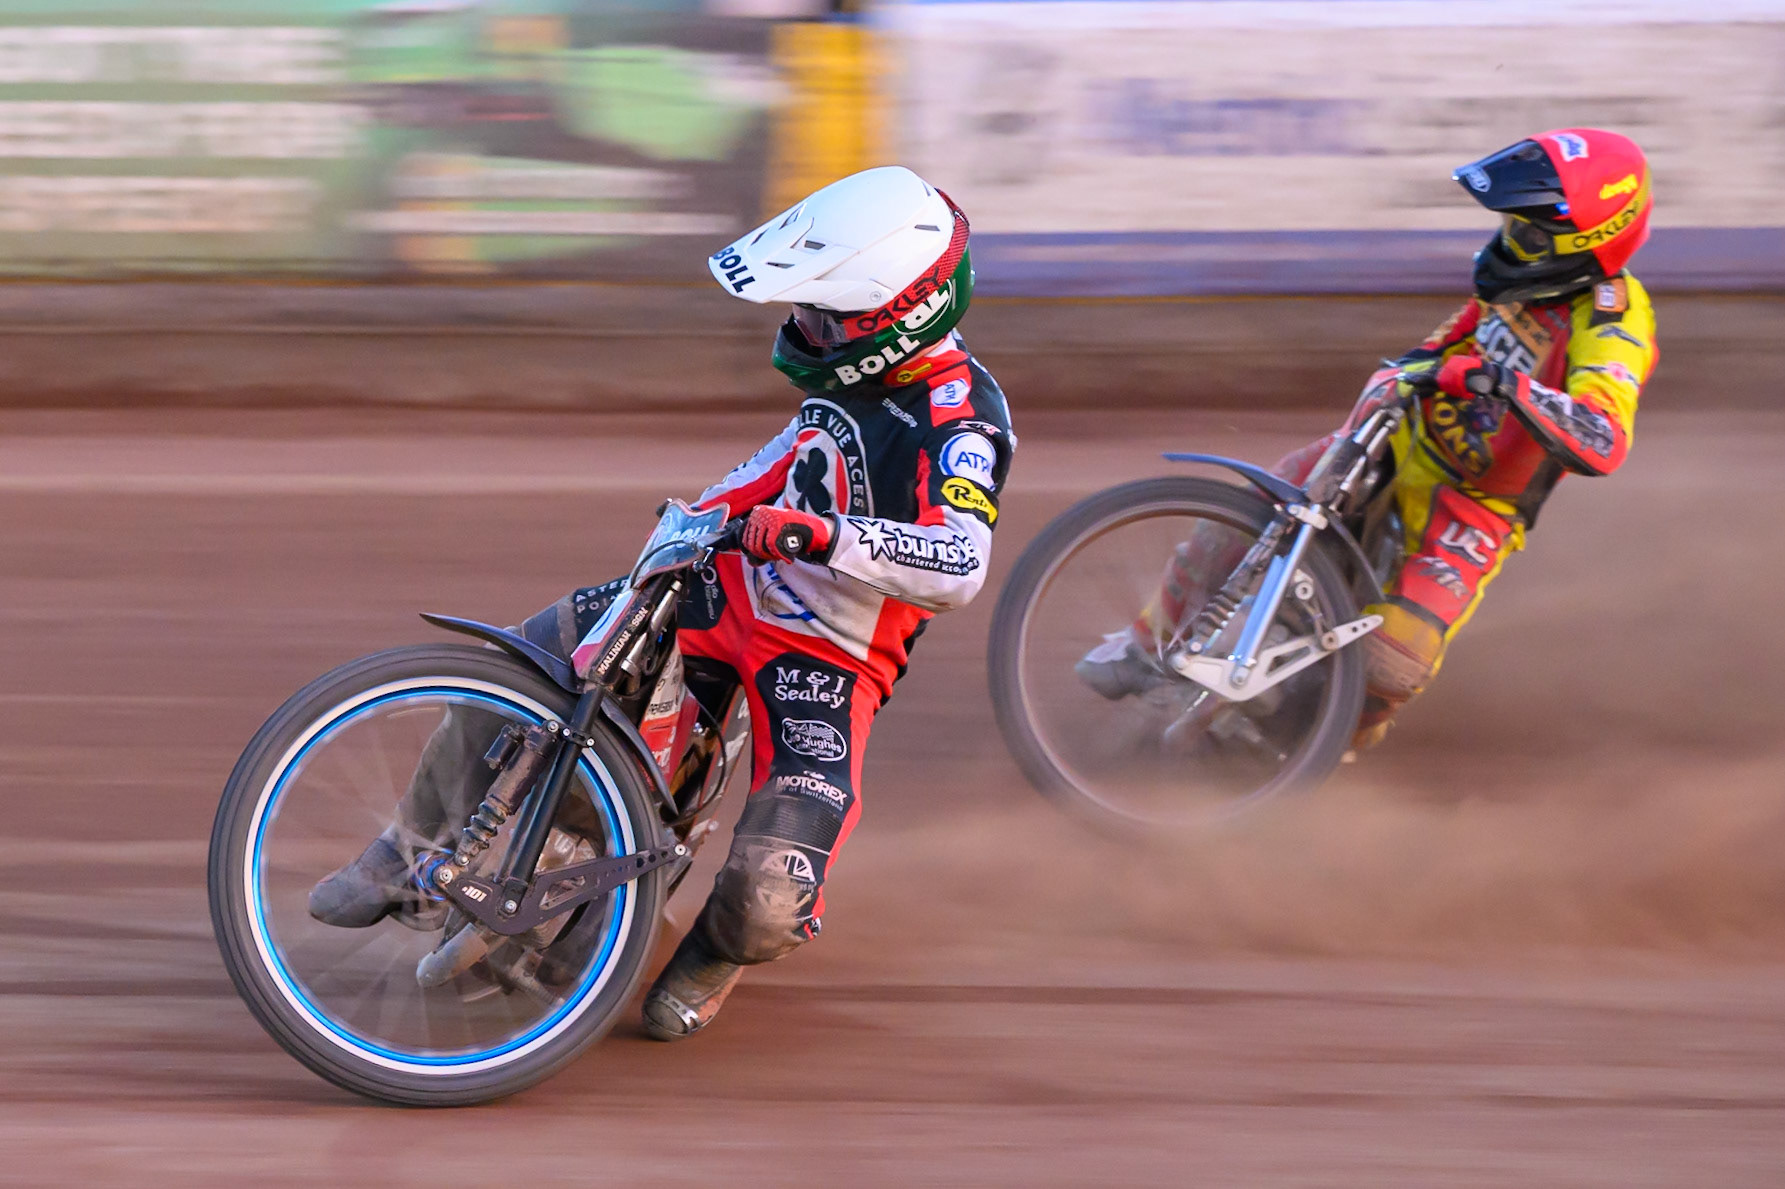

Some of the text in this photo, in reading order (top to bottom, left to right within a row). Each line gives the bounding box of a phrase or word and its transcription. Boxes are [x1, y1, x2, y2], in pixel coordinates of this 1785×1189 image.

[712, 247, 755, 293] BOLL
[856, 266, 940, 332] OAKLEY
[834, 334, 921, 386] BOLL
[827, 413, 852, 449] VUE
[847, 455, 865, 508] ACES
[775, 684, 846, 710] Sealey
[776, 666, 847, 694] M & J
[776, 775, 848, 806] MOTOREX
